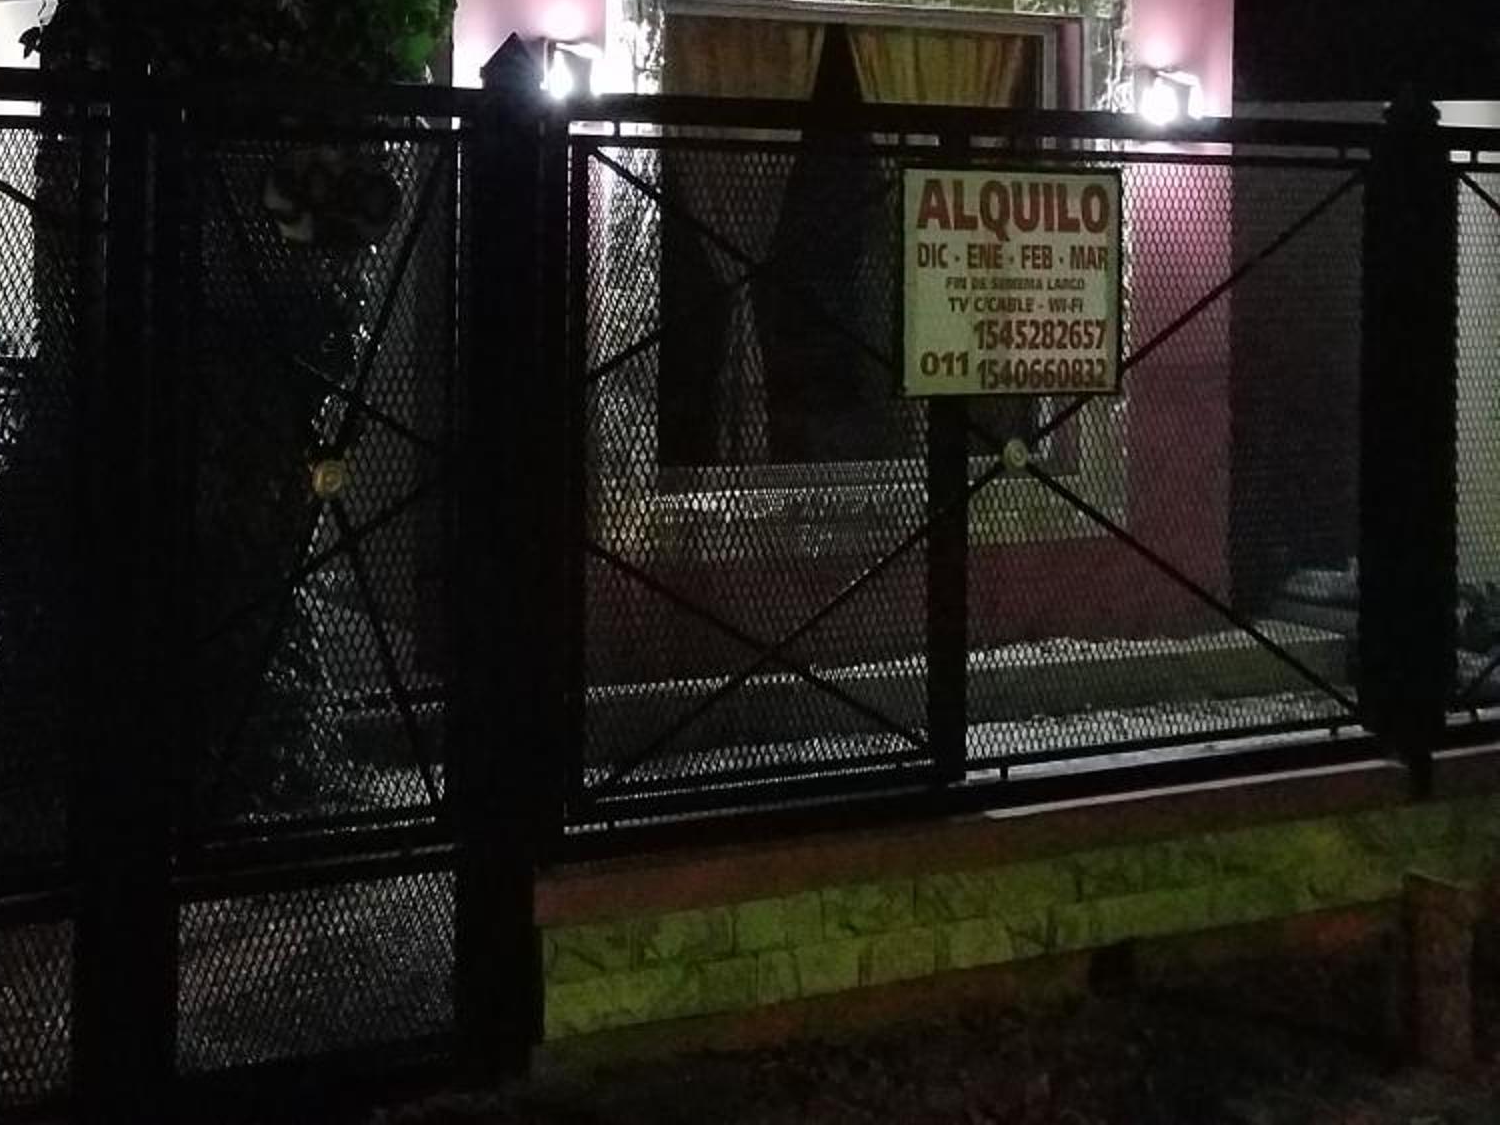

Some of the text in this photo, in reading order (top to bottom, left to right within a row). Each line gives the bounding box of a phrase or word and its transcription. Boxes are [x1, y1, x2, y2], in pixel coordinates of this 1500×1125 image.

[916, 178, 1110, 242] ALQUILO
[917, 242, 949, 268] DIC
[967, 243, 1004, 270] ENE
[1021, 244, 1053, 270] FEB
[1069, 244, 1109, 271] MAR
[947, 296, 969, 313] TV
[973, 319, 1107, 350] 1545282657
[920, 351, 969, 377] 011
